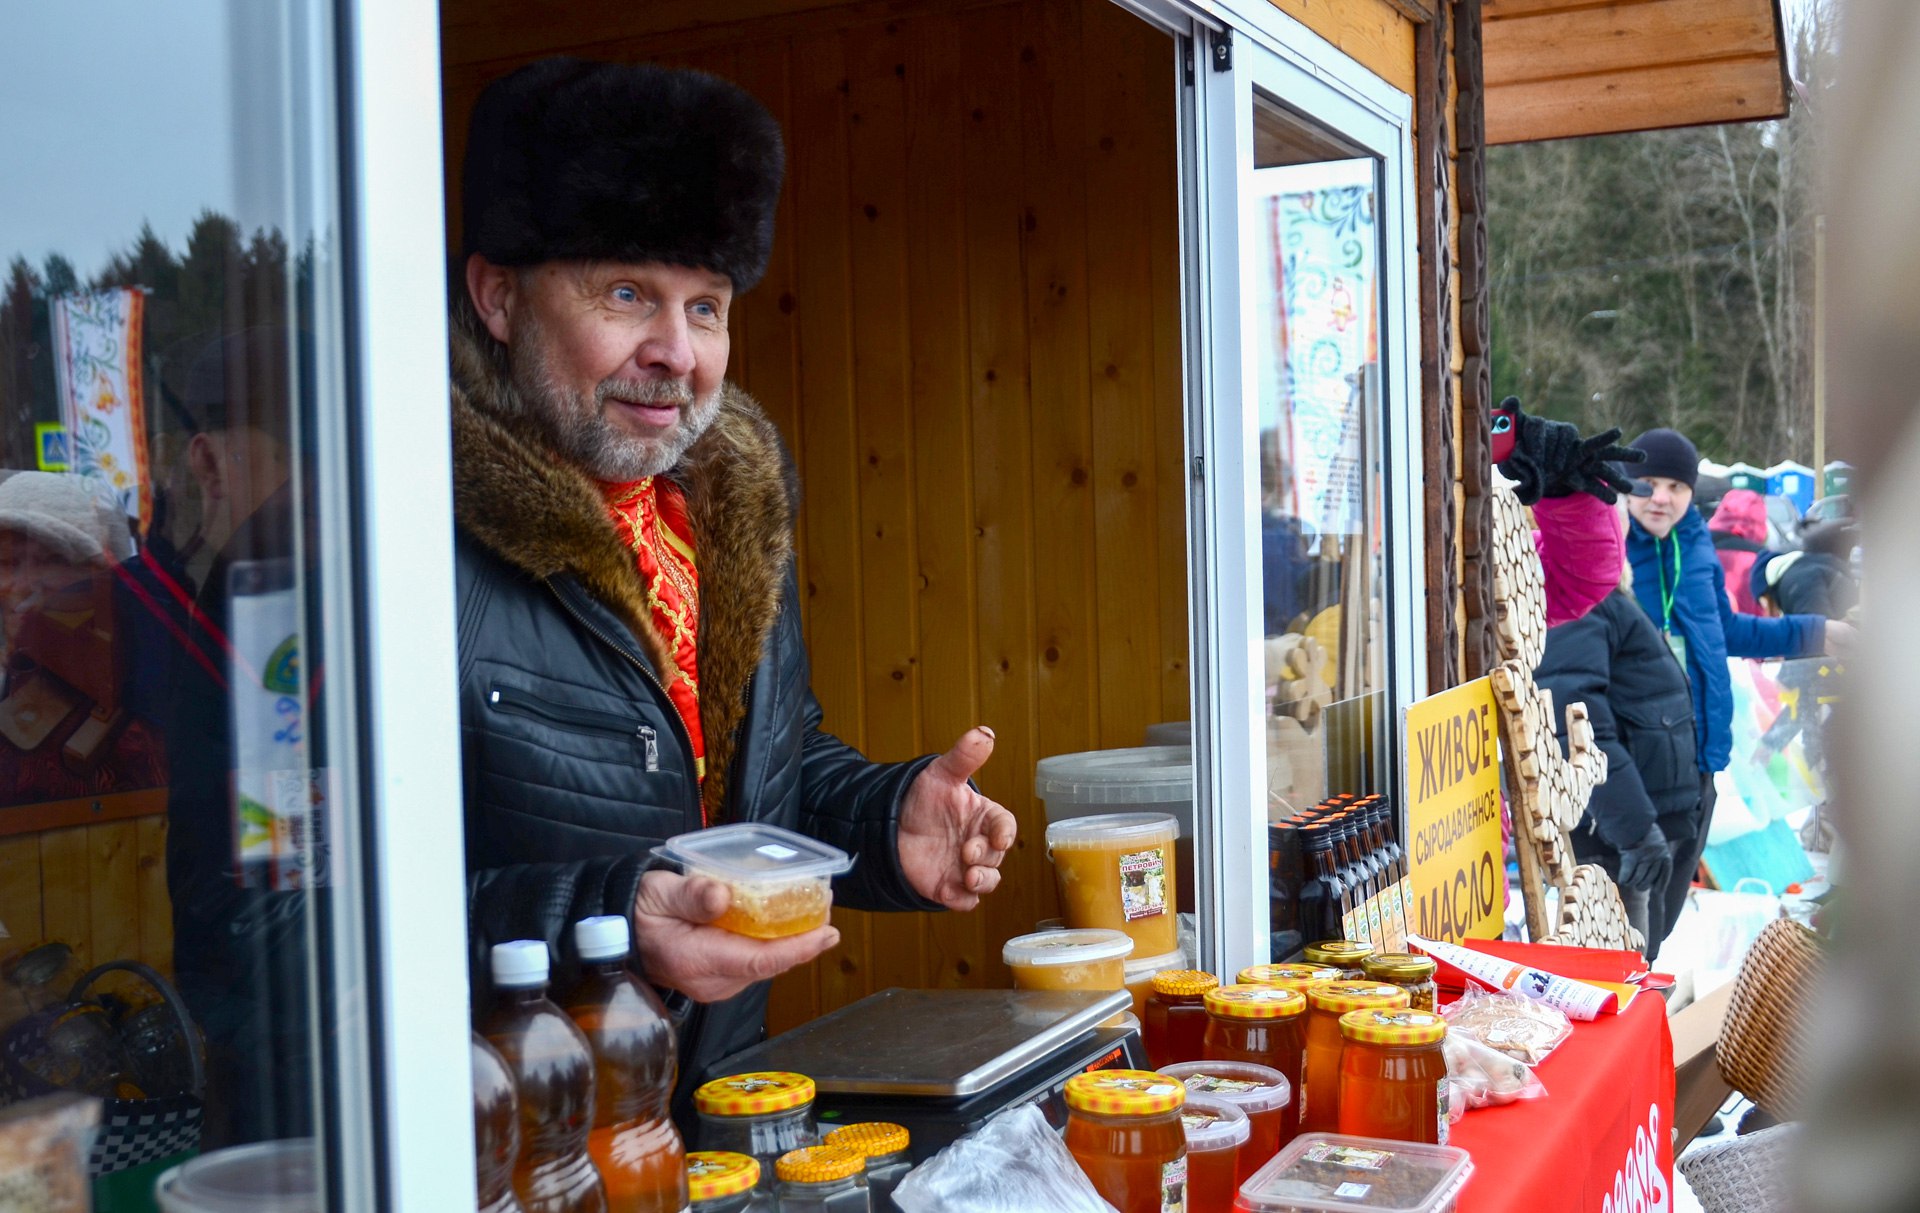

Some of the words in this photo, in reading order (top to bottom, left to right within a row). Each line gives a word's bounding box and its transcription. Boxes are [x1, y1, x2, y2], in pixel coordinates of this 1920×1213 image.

[1417, 703, 1490, 803] ЖИВОЕ
[1122, 859, 1162, 872] ПЕТРОВИЧ
[1415, 788, 1495, 865] СЫРОДАВЛЕННОЕ
[1419, 850, 1495, 943] МАСЛО
